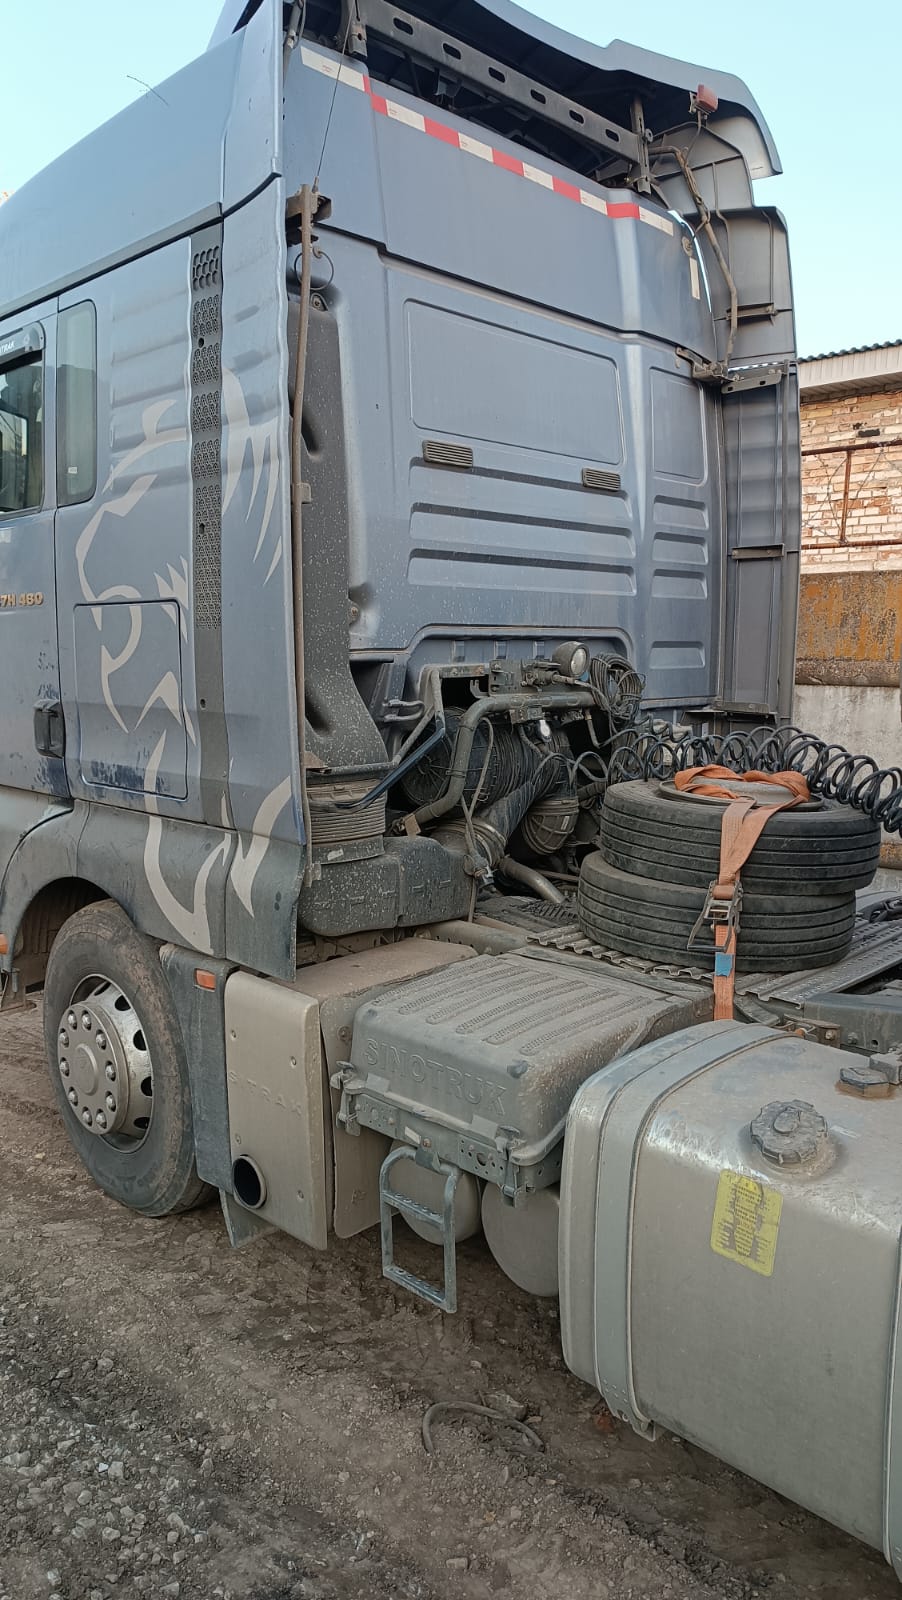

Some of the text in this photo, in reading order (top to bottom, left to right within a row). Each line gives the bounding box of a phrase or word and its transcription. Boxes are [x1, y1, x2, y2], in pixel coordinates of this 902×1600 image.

[0, 591, 44, 607] 7H 480
[228, 1071, 303, 1118] STRAK
[364, 1038, 507, 1116] SINOTRUK
